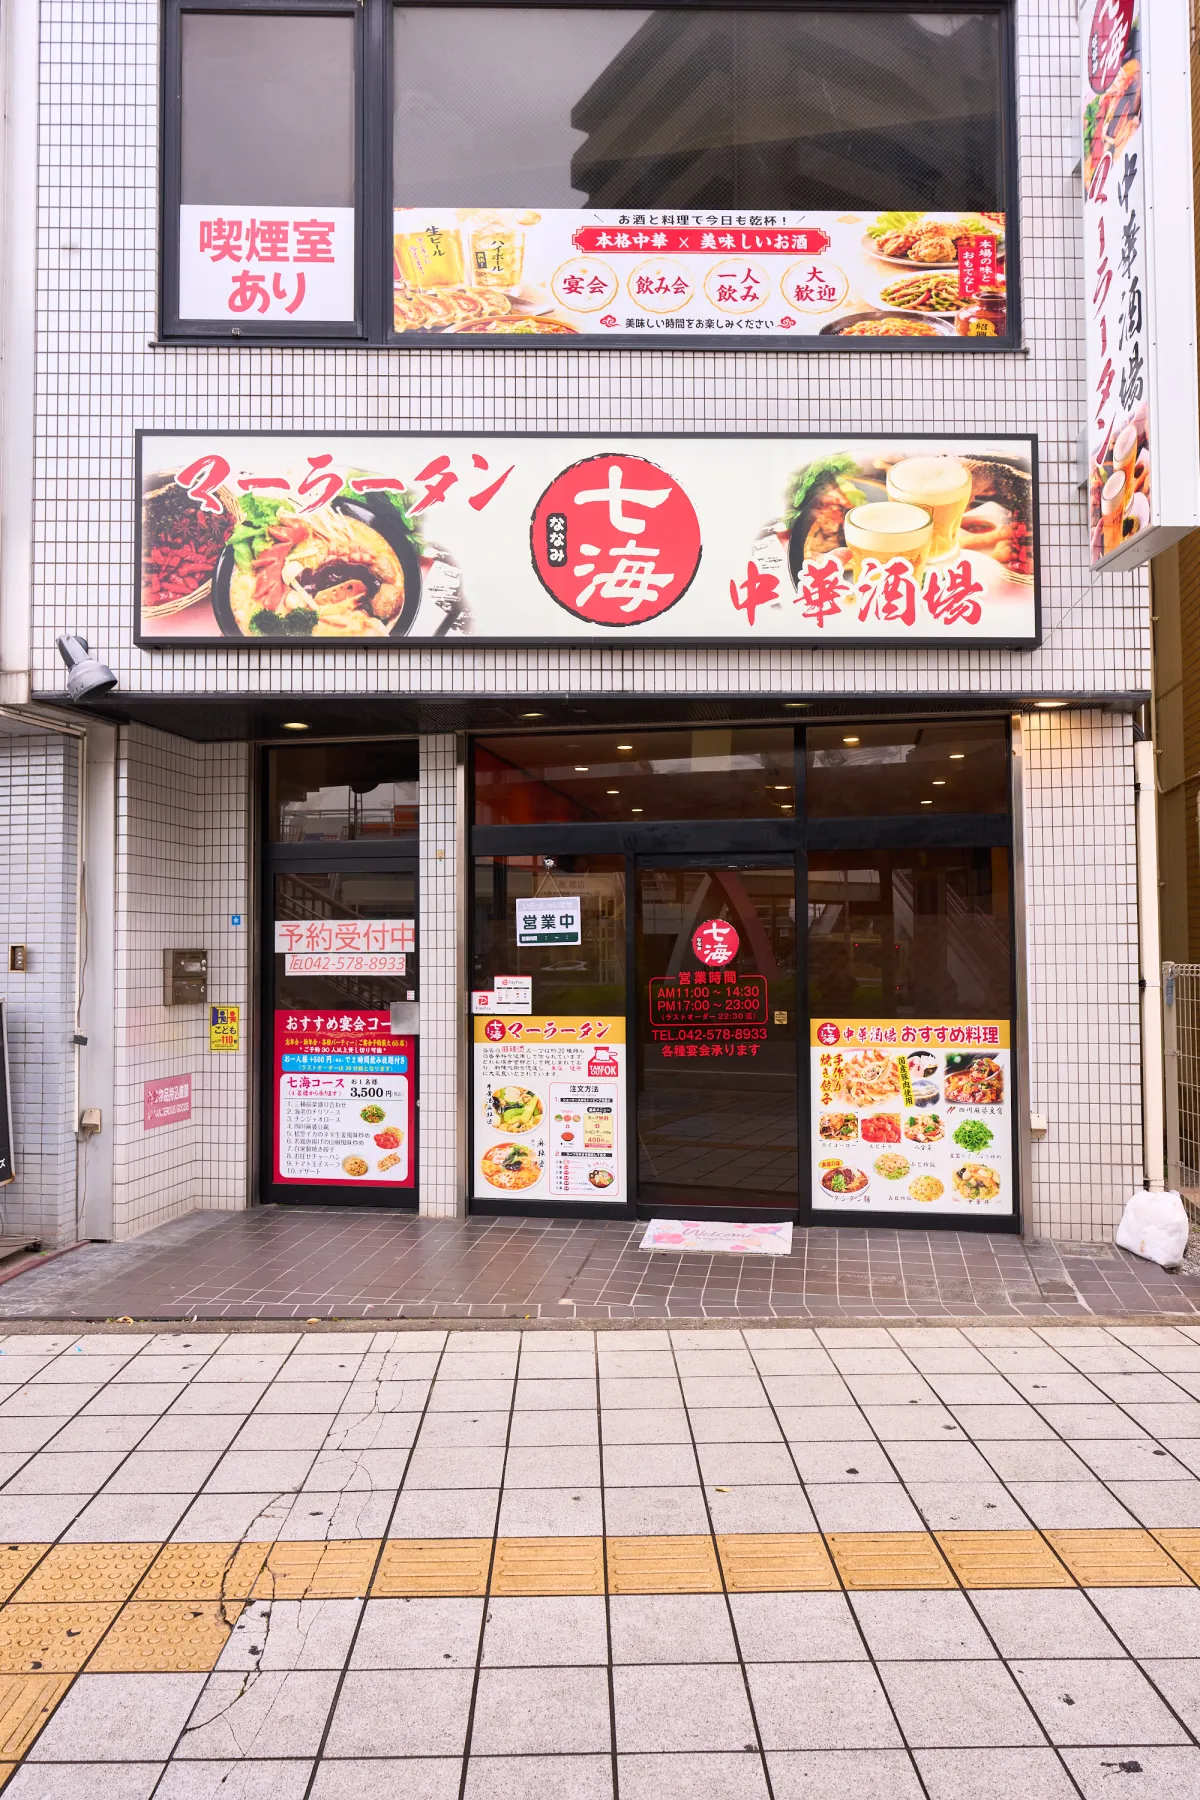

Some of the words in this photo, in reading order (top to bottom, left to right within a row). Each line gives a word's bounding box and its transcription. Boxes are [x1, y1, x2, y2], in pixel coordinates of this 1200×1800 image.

[199, 218, 335, 264] 喫煙室
[425, 225, 446, 257] 生ビール
[595, 231, 669, 250] 本格中華
[700, 231, 808, 251] 美味しいお酒
[490, 240, 505, 272] ハイボール
[979, 239, 992, 283] 本場の味と
[717, 267, 760, 285] 一人
[806, 266, 824, 284] 大
[962, 251, 975, 293] おもてなし
[1118, 152, 1144, 411] 中華酒場
[228, 270, 306, 314] あり
[562, 275, 608, 295] 宴会
[635, 275, 690, 295] 飲み会
[716, 285, 760, 303] 飲み
[794, 284, 838, 303] 歓迎
[1088, 151, 1116, 466] マーラータン
[625, 317, 774, 331] 美味しい時間をお楽しみください
[176, 453, 516, 516] マーラータン
[548, 514, 566, 564] ななみ
[573, 465, 675, 613] 七海
[729, 559, 982, 628] 中華酒場
[523, 913, 574, 930] 営業中
[279, 922, 415, 951] 予約受付中
[703, 922, 732, 964] 七海
[678, 971, 737, 985] 営業時間
[657, 987, 710, 999] AM11:00
[726, 985, 760, 997] 14:30
[657, 1000, 710, 1011] PM17:00
[725, 999, 760, 1010] 23:00
[214, 1026, 237, 1035] こども
[285, 1015, 392, 1031] おすすめ宴会コー
[507, 1021, 611, 1039] マーラータン
[651, 1028, 768, 1041] TEL.042-578-8933
[843, 1026, 897, 1043] 中華酒場
[901, 1025, 999, 1044] おすすめ料理
[661, 1044, 761, 1057] 各種宴会承ります
[604, 1065, 617, 1076] OK
[286, 1076, 345, 1089] 七海コース
[569, 1085, 599, 1093] 注文方法
[682, 1227, 757, 1239] Welcome
